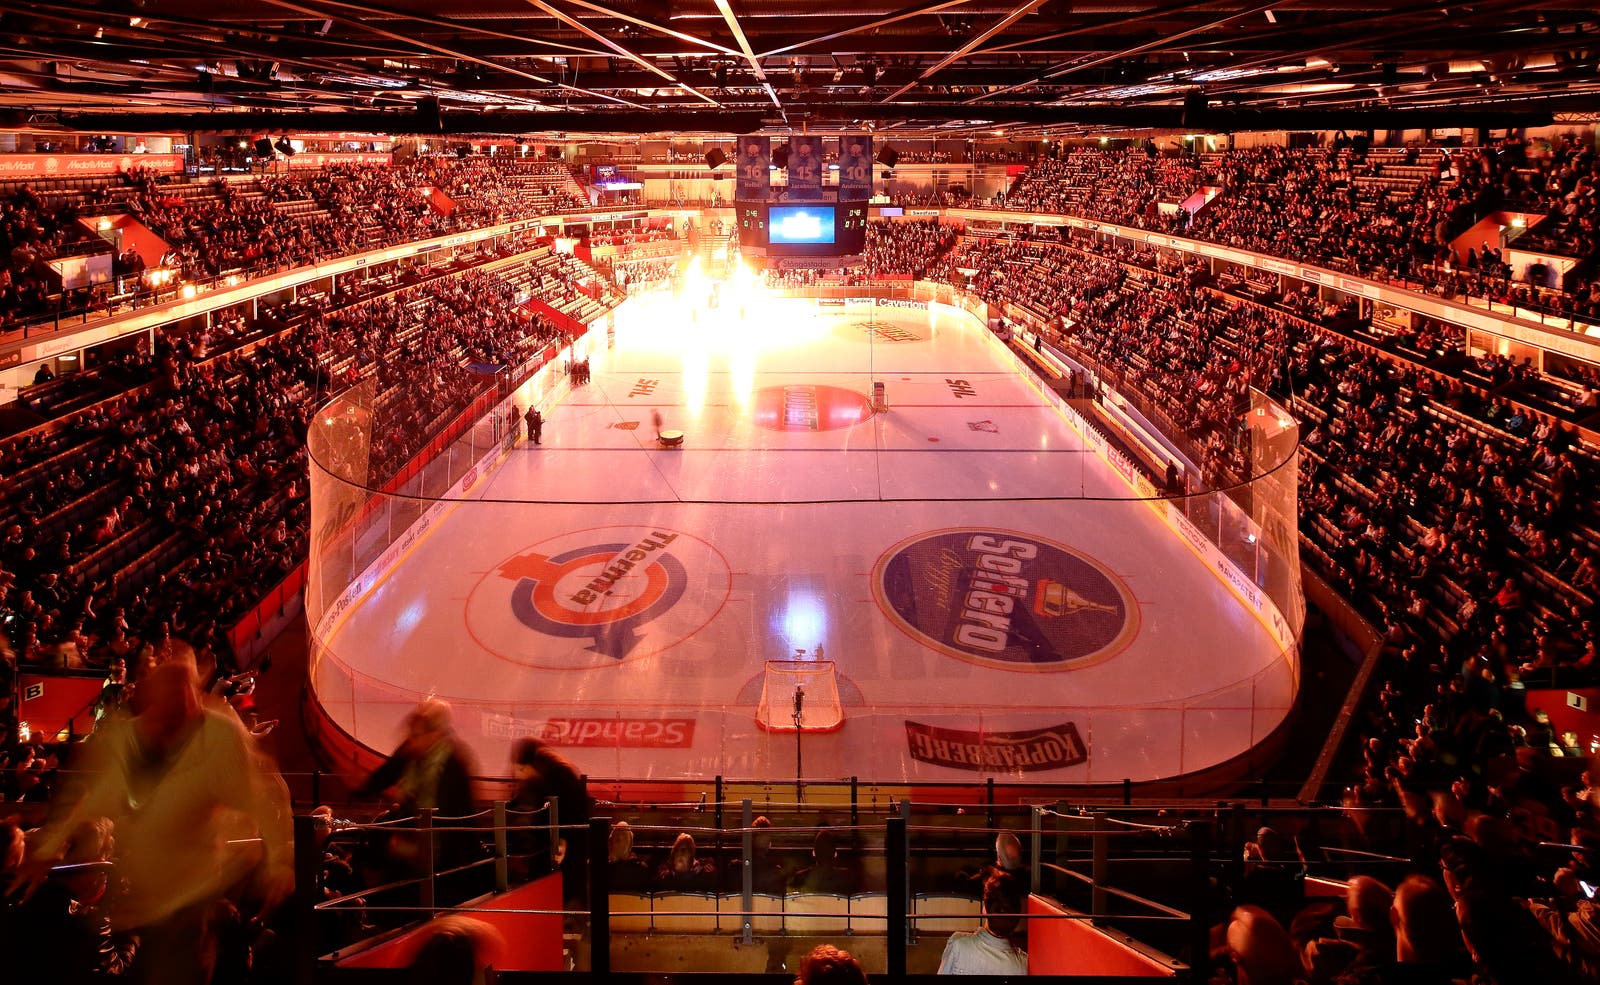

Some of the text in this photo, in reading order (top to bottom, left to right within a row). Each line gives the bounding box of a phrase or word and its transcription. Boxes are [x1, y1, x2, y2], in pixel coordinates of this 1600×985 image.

[744, 165, 762, 179] 16
[797, 166, 814, 180] 15
[847, 166, 865, 180] 10
[878, 298, 927, 311] Caverion
[945, 378, 978, 399] SHL
[569, 530, 679, 606] Thermia
[953, 534, 1038, 653] Sofiero
[26, 685, 41, 699] B
[550, 721, 687, 745] Scandic
[913, 731, 1080, 767] KOPPARBERG
